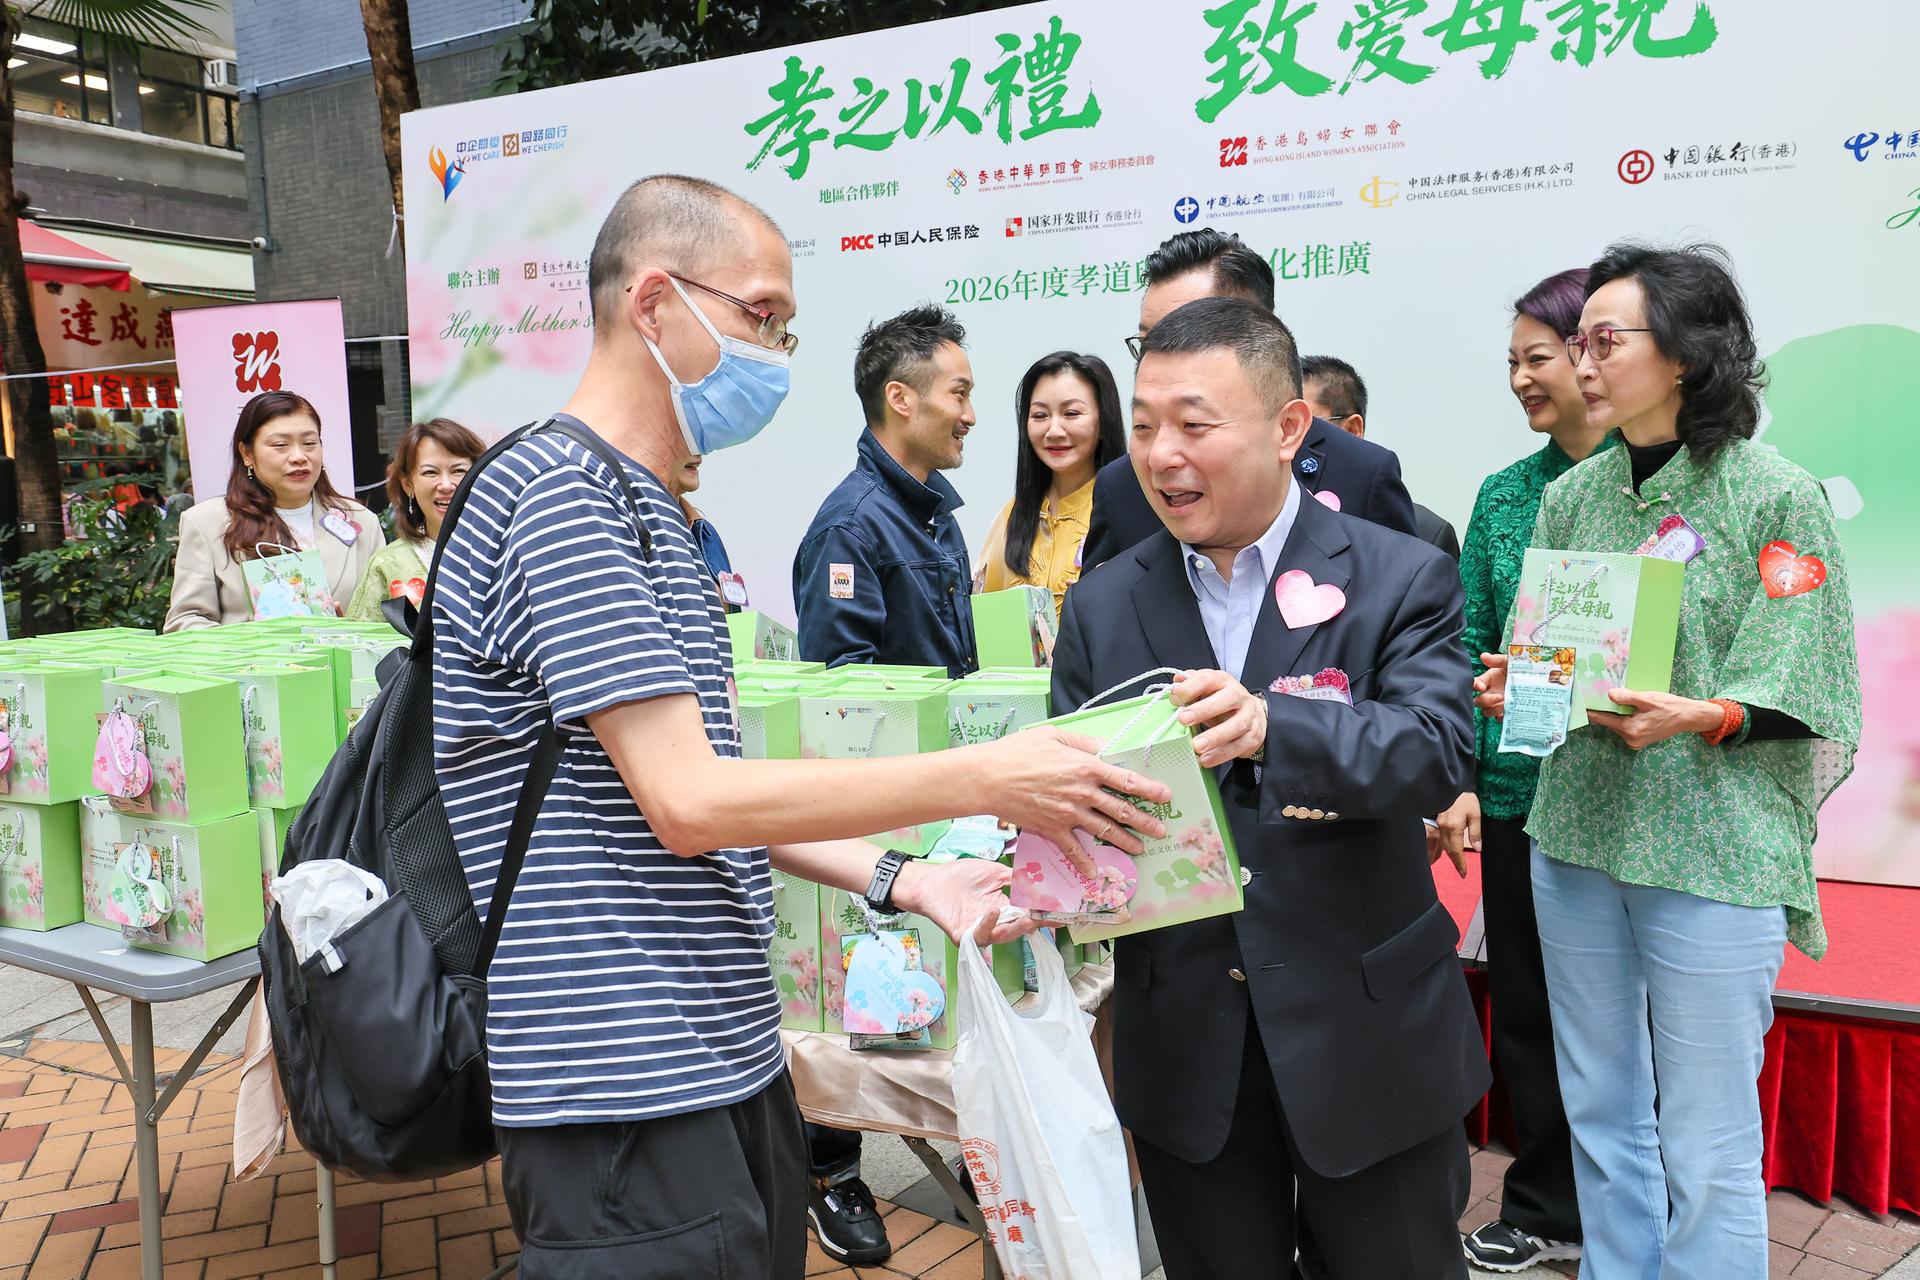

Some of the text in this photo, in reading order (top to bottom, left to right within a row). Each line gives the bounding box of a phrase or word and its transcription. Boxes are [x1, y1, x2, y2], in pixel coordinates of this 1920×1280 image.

[744, 15, 1101, 181] 孝之以禮
[521, 125, 568, 143] 同路同行
[1254, 119, 1402, 151] 香港島婦女聯會
[471, 141, 565, 162] WE CARE WE CHERISH
[1088, 154, 1156, 172] 婦女事務委員會
[1253, 156, 1274, 165] HONG
[1274, 154, 1295, 163] KONG
[1295, 150, 1322, 161] ISLAND
[1357, 141, 1406, 154] ASSOCIATION
[1884, 151, 1917, 160] CHINA
[1023, 180, 1051, 188] FRIENDSHIP
[1052, 176, 1084, 185] ASSOCIATION
[1408, 161, 1575, 189] 中国法律服务(香港)有限公司
[1663, 171, 1693, 181] BANK
[1695, 168, 1710, 178] OF
[1712, 166, 1748, 177] CHINA
[818, 180, 900, 204] 地區合作夥伴
[1406, 178, 1575, 201] CHINA LEGAL SERVICES (H.K.) LTD.
[1028, 207, 1142, 230] 国家开发银行 香港分行
[1222, 210, 1244, 218] NATIONAL
[1245, 208, 1267, 216] AVIATION
[1267, 205, 1301, 214] CORPORATION
[1321, 200, 1343, 208] LIMITED
[877, 224, 981, 249] 中国人民保险
[1045, 226, 1084, 235] DEVELOPMENT
[1084, 223, 1100, 231] BANK
[841, 234, 874, 252] PICC
[1268, 241, 1371, 280] 化推廣
[447, 267, 500, 290] 聯合主辦
[439, 301, 595, 349] Happy Mother's
